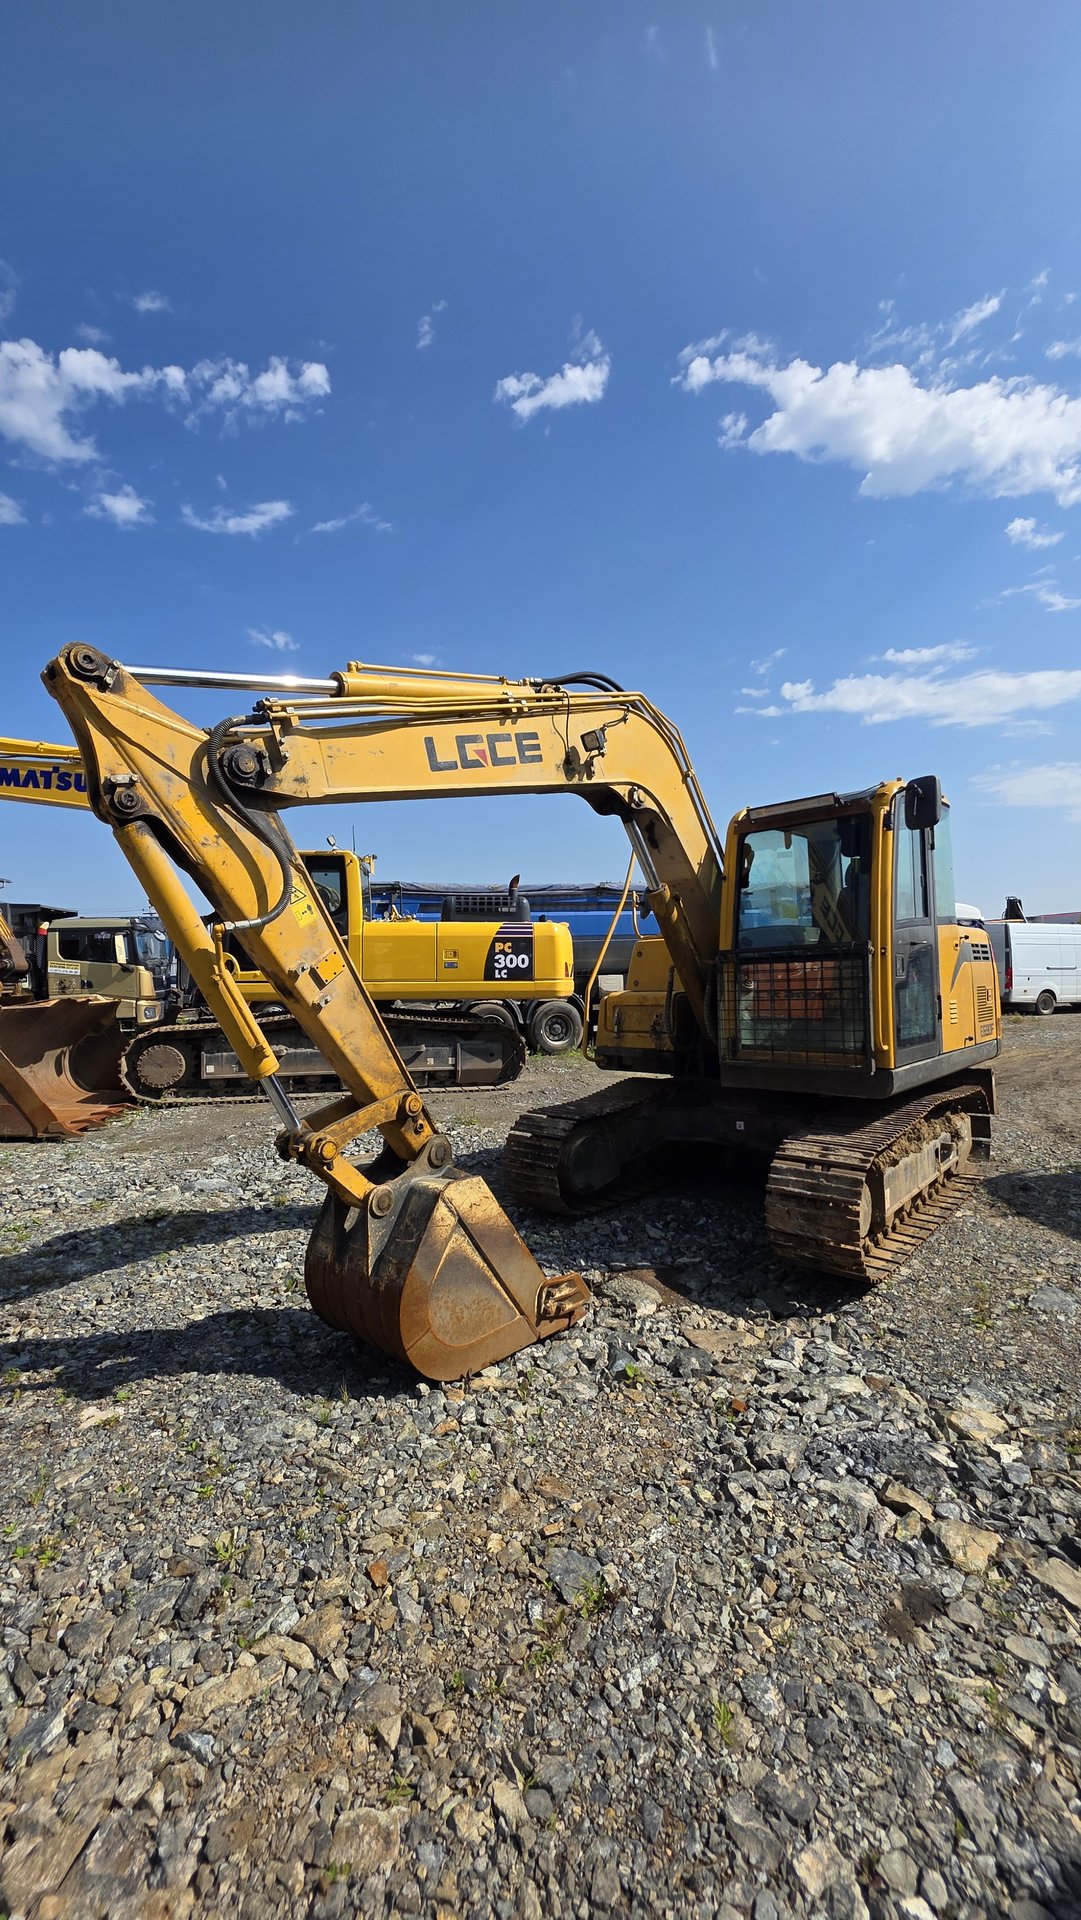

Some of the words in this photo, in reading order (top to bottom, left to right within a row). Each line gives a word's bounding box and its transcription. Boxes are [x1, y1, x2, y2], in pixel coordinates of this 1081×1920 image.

[494, 942, 512, 953] PC
[494, 954, 529, 968] 300
[494, 969, 507, 979] LC
